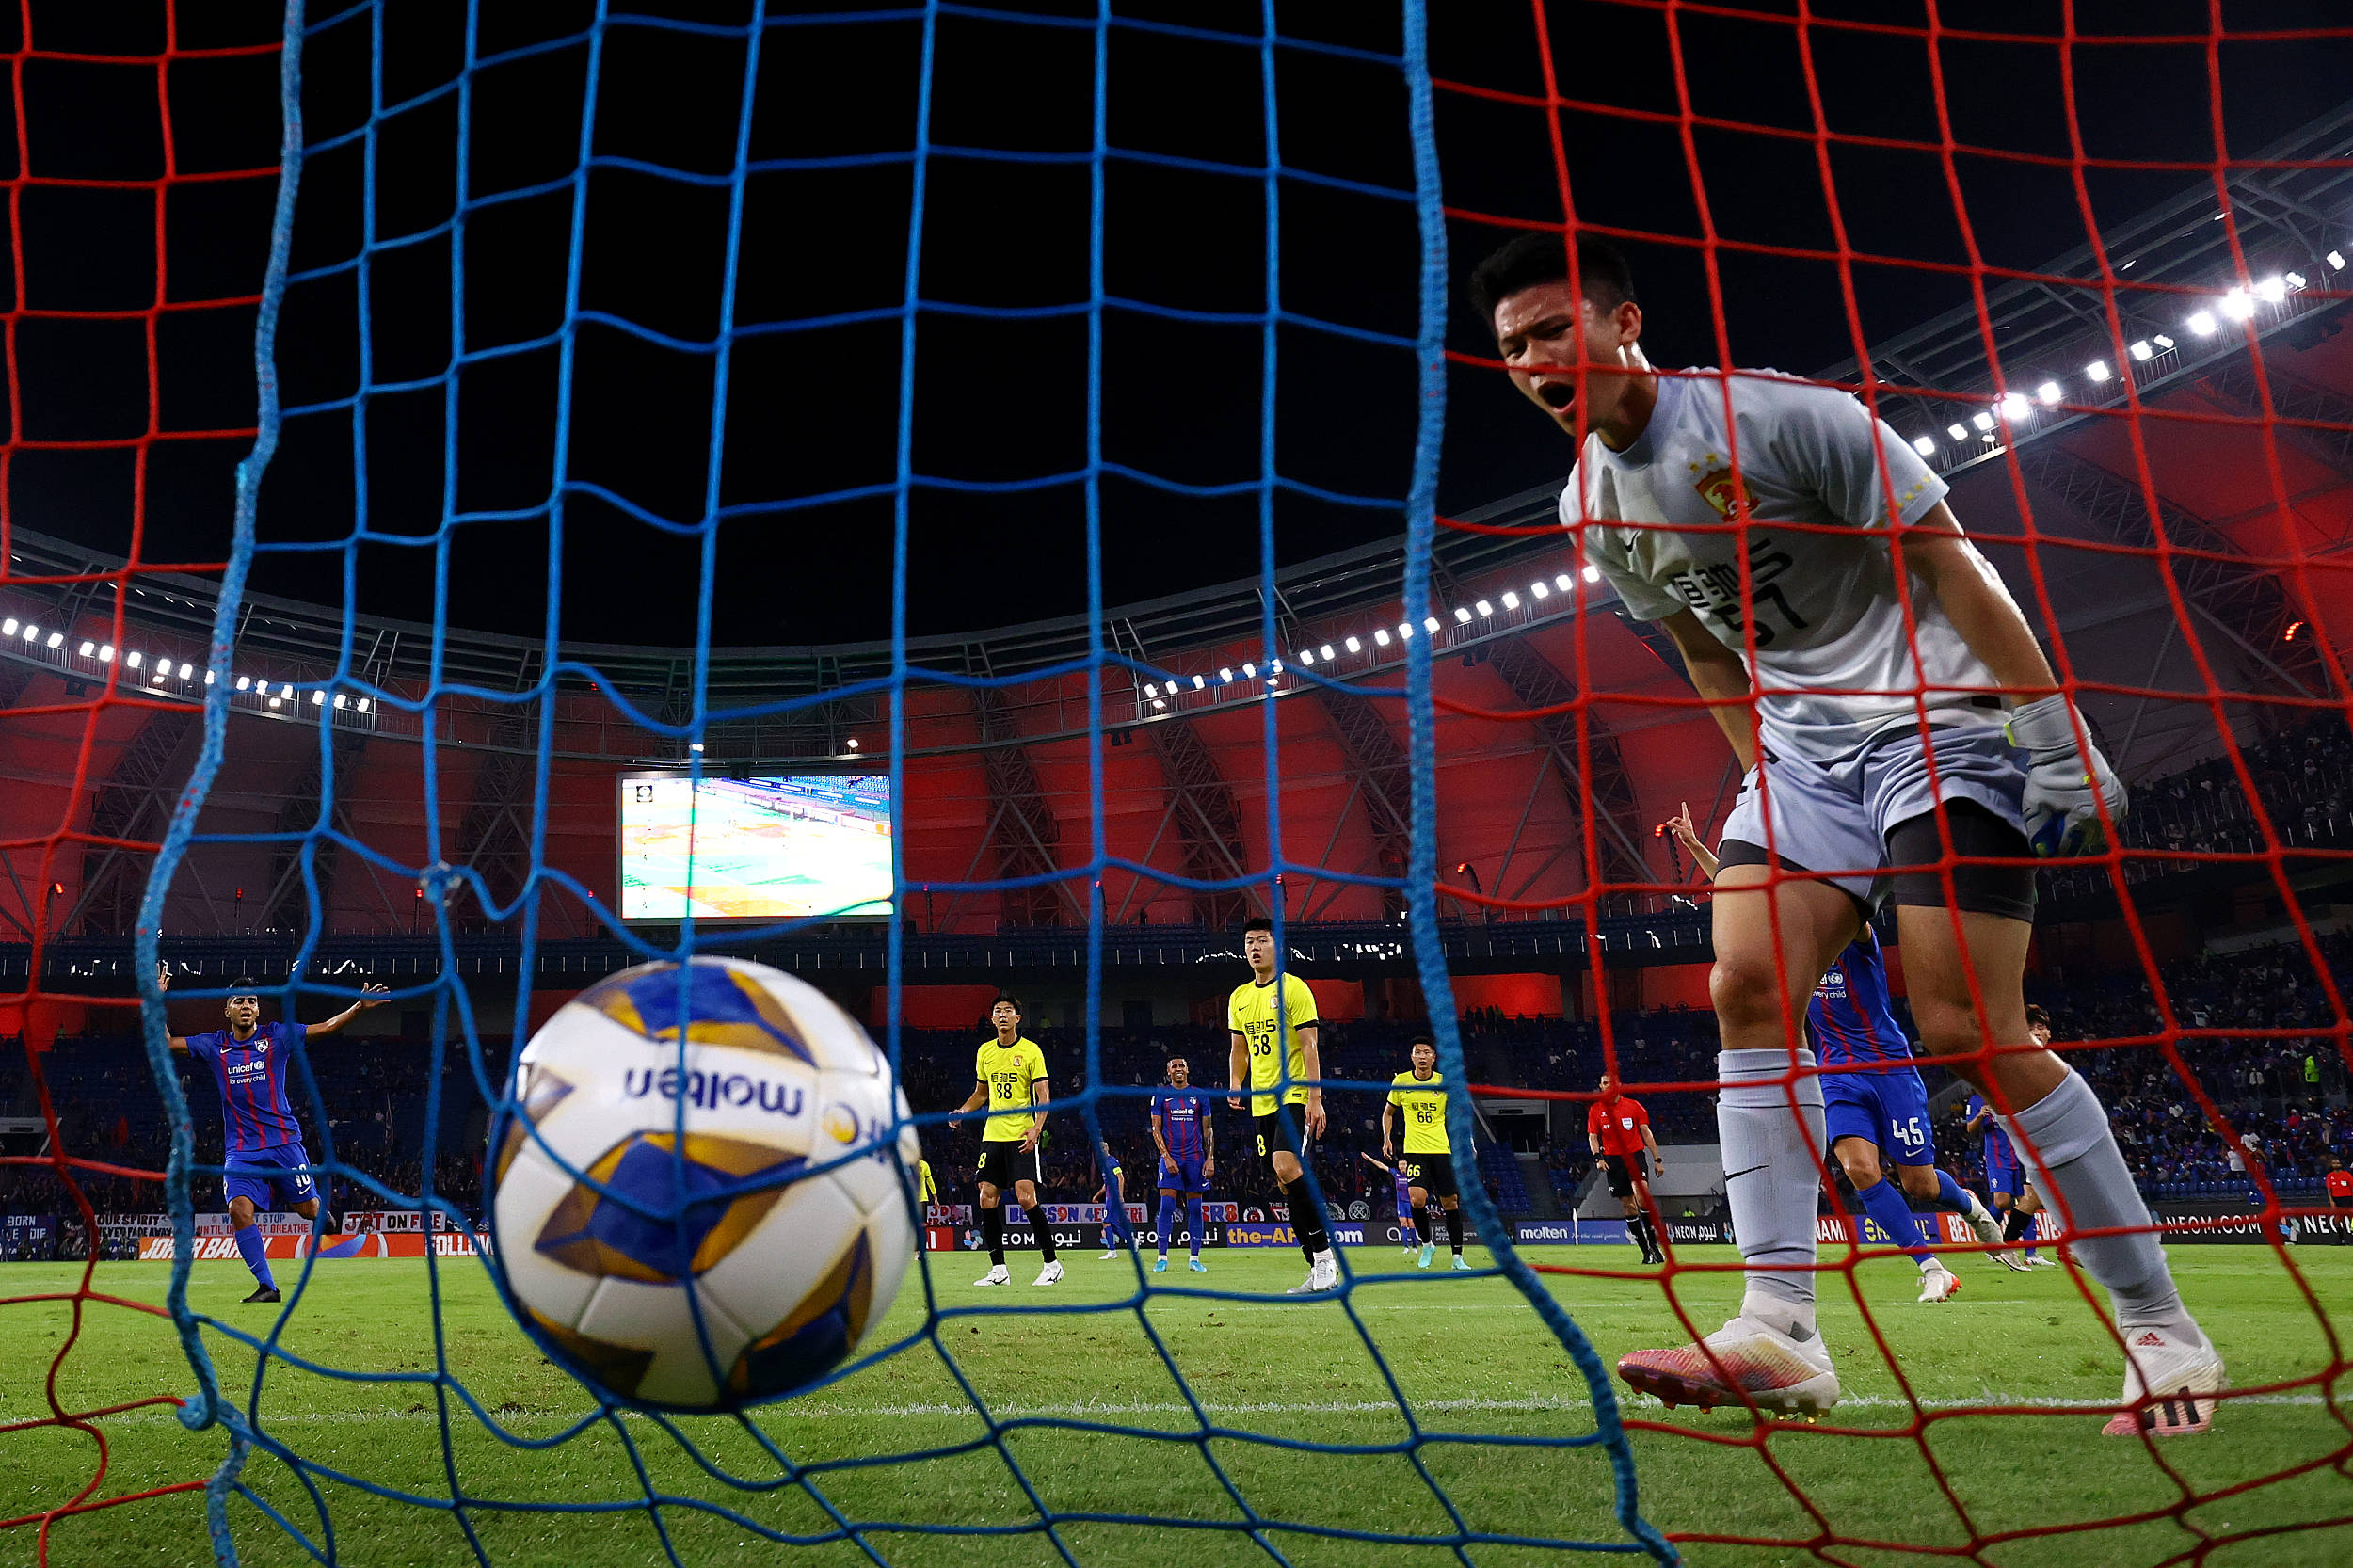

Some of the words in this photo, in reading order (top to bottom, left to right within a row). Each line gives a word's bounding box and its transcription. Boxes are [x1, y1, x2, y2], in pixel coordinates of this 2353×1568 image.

[1710, 582, 1809, 647] 57
[1252, 1033, 1272, 1057] 58
[228, 1062, 254, 1075] unicef
[236, 1076, 252, 1084] every
[252, 1073, 266, 1081] child
[624, 1065, 805, 1118] molten
[1417, 1111, 1433, 1123] 66
[1892, 1117, 1925, 1146] 45
[1406, 1164, 1421, 1177] 66
[121, 1214, 160, 1225] SPIRIT
[263, 1213, 286, 1224] STOP
[387, 1214, 408, 1229] ON
[410, 1213, 440, 1230] FIE
[2166, 1215, 2262, 1235] NEOM.COM
[270, 1223, 309, 1234] BREATHE
[1520, 1226, 1568, 1240] molten
[1675, 1225, 1696, 1239] NEOM
[1698, 1222, 1717, 1241] نيوم
[1001, 1233, 1035, 1245] EOM
